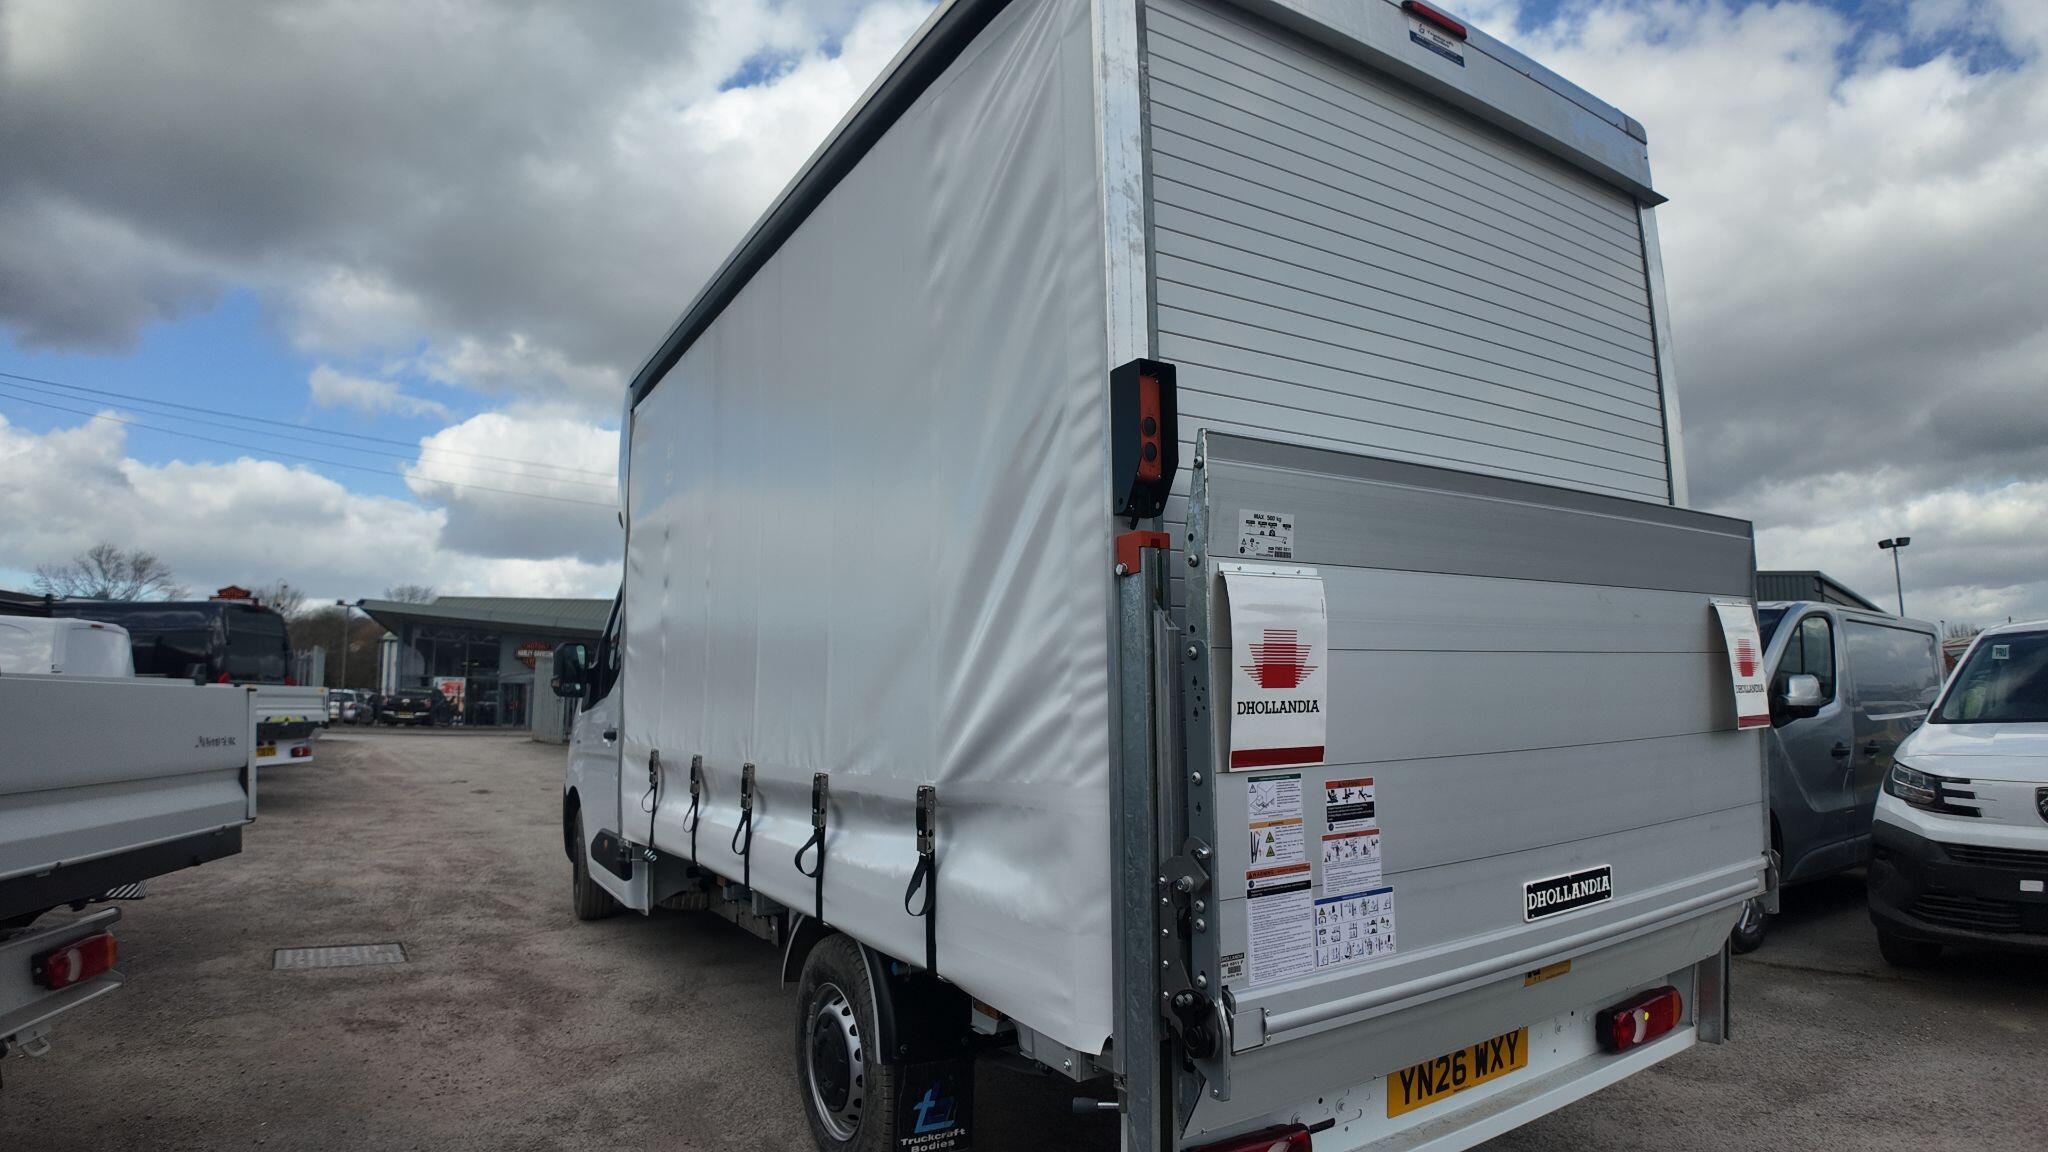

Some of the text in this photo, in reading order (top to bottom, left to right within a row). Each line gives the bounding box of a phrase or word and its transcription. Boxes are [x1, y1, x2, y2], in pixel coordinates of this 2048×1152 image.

[1237, 700, 1320, 715] DHOLLANDIA
[1527, 875, 1611, 910] DHOLLANDIA
[1399, 1030, 1519, 1105] YN26 WXY
[900, 1128, 966, 1146] Truckcraft
[911, 1139, 955, 1152] Bodies
